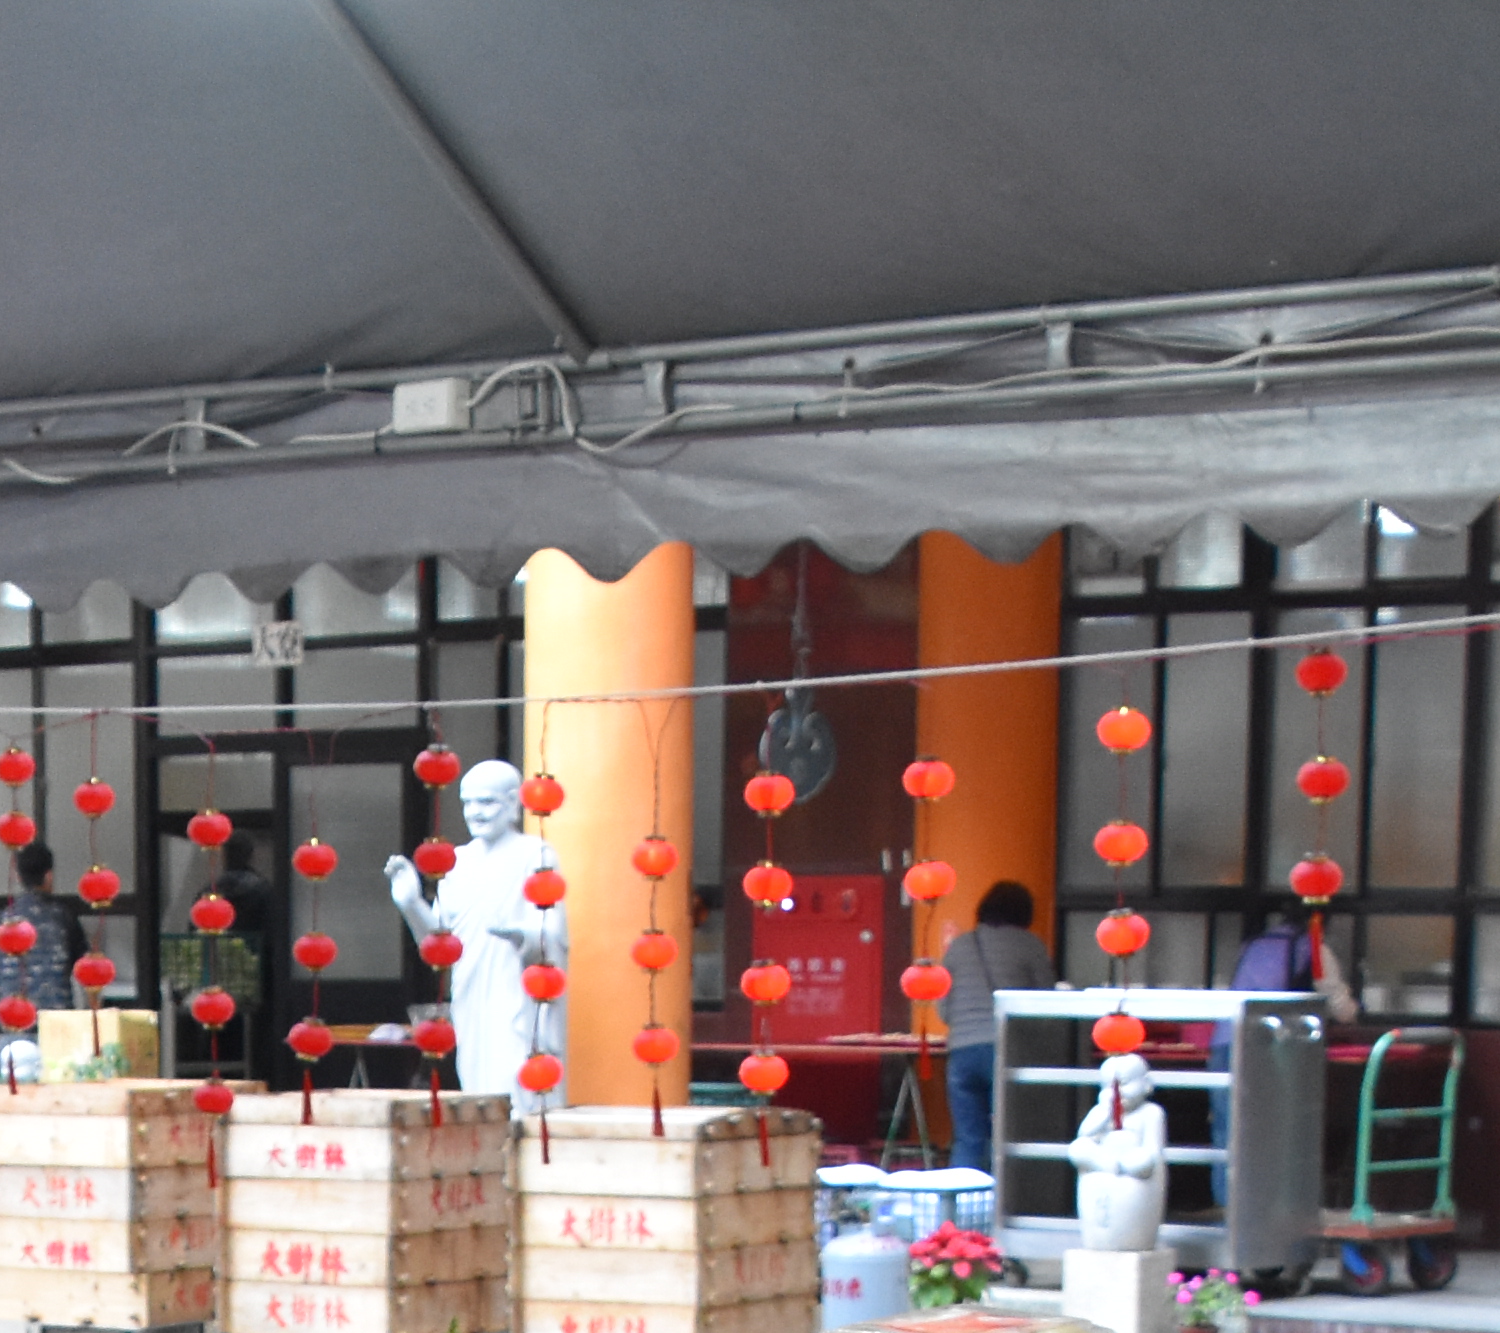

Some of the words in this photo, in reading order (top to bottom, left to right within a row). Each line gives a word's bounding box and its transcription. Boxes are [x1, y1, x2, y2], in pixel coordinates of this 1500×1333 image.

[269, 1142, 346, 1171] 大樹林
[23, 1176, 95, 1208] 大樹林
[561, 1206, 653, 1248] 大樹林
[22, 1239, 91, 1265] 大樹林
[262, 1240, 348, 1284] 大樹林
[266, 1294, 350, 1329] 大樹林
